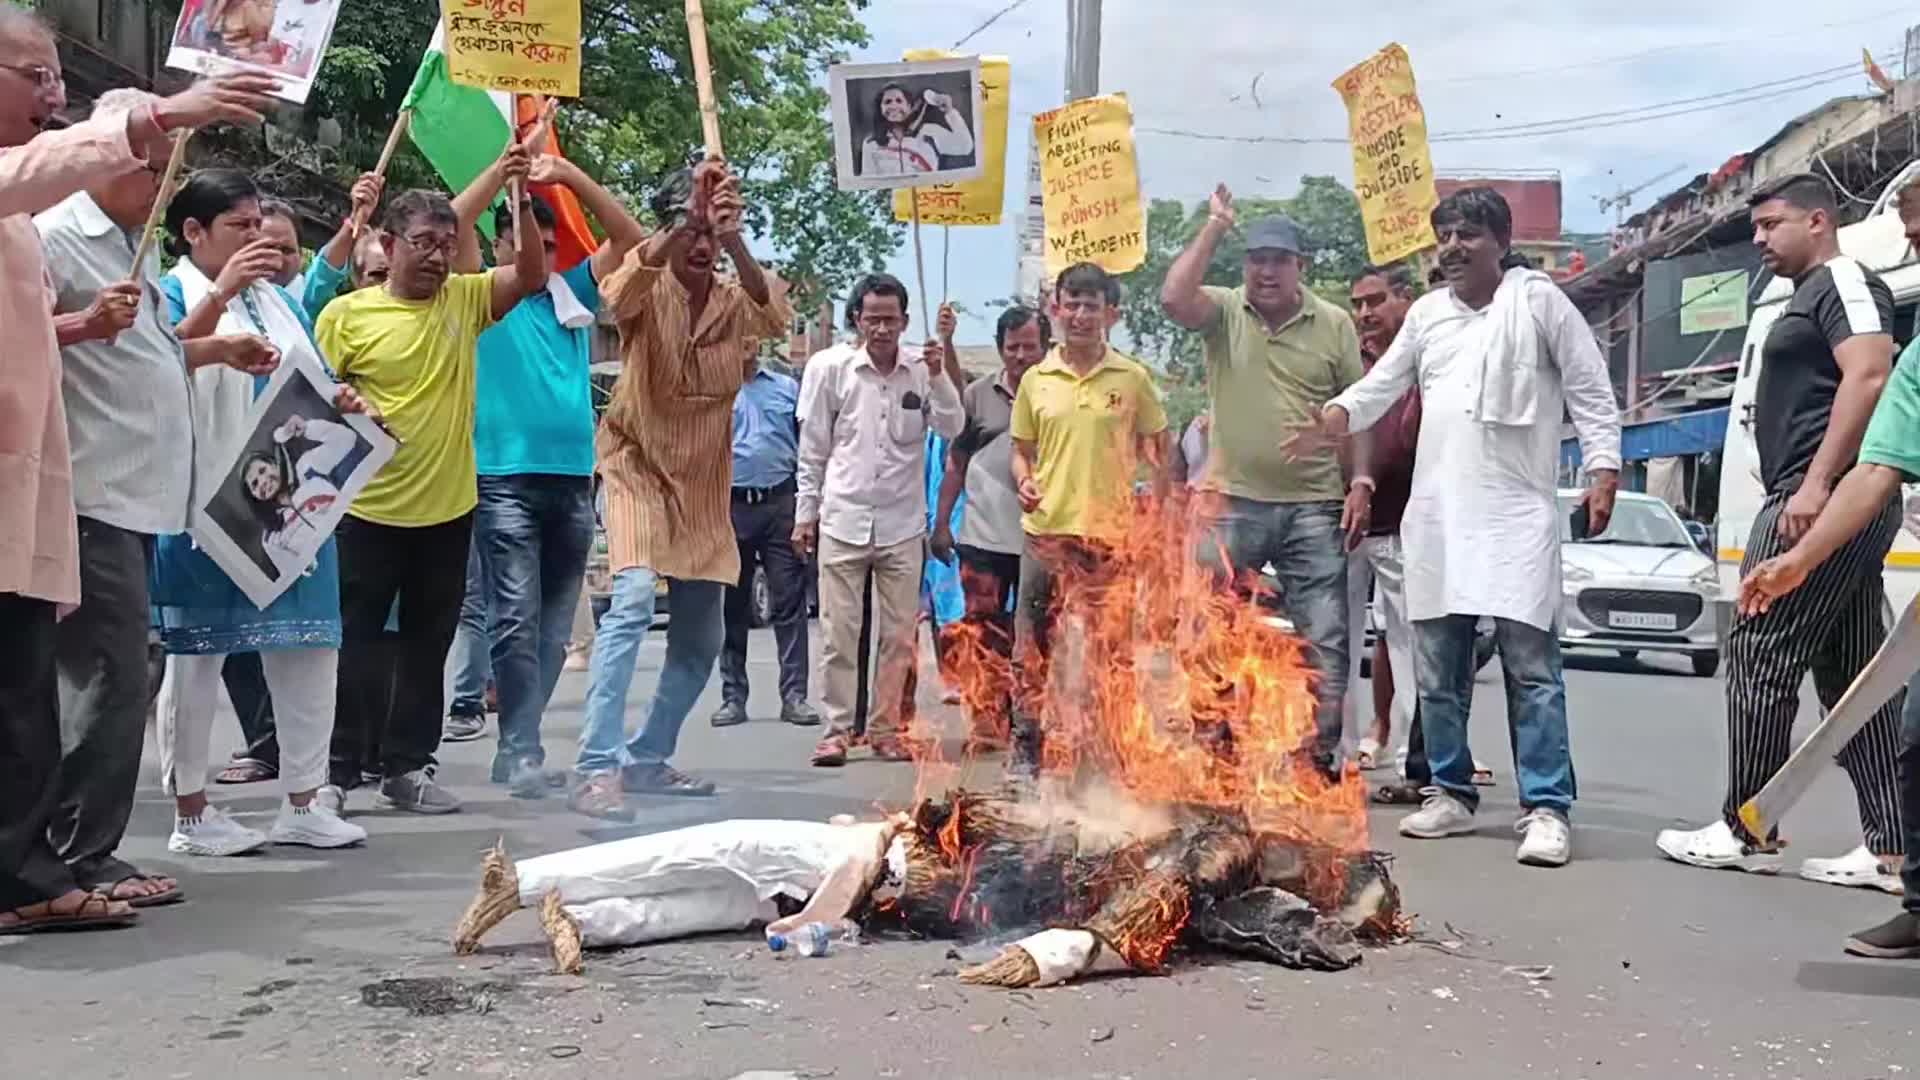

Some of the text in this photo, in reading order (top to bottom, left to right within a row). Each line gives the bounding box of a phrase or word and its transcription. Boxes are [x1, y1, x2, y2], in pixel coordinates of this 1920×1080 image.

[1047, 115, 1089, 144] FIGHT
[1365, 124, 1405, 157] INSIDE
[1047, 137, 1087, 160] ABOUT
[1063, 140, 1121, 168] GETTING
[1378, 152, 1402, 172] AND
[1047, 159, 1114, 196] JUSTICE
[1360, 159, 1424, 200] OUTSIDE
[1061, 196, 1119, 227] PUNISH
[1065, 231, 1140, 262] PRESIDENT
